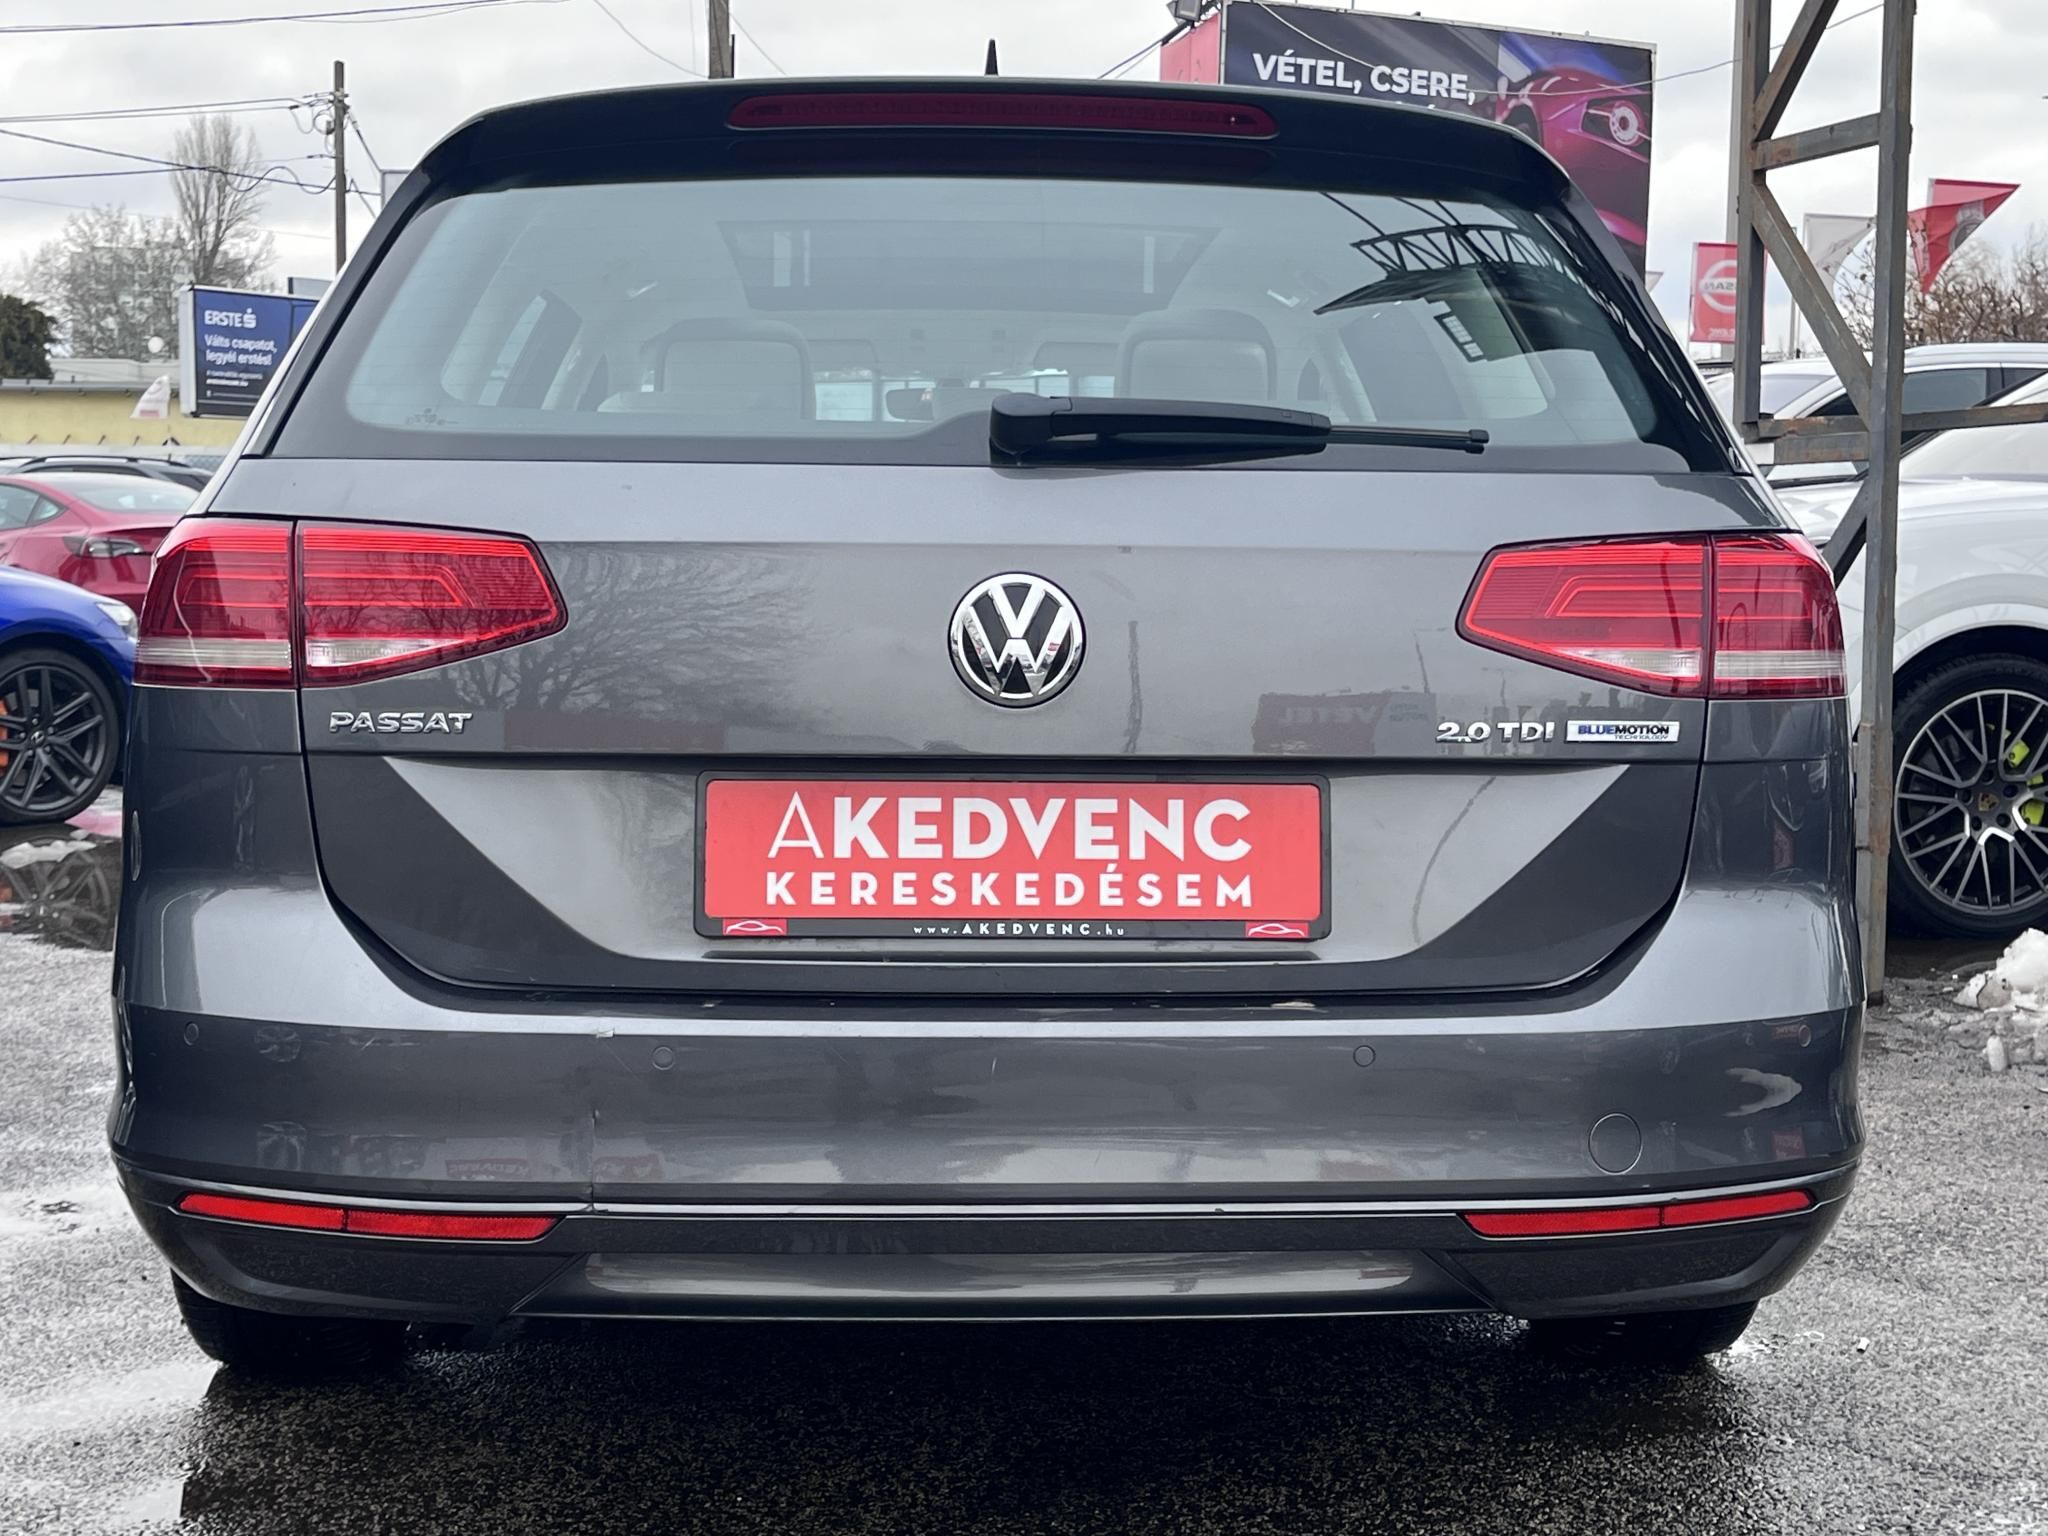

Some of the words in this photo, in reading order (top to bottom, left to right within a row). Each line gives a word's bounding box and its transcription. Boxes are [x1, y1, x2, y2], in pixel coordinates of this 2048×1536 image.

[1253, 49, 1362, 94] VÉTEL,
[1370, 65, 1476, 106] CSERE,
[204, 309, 243, 328] ERSTE
[329, 711, 473, 734] PASSAT
[1436, 721, 1492, 742] 2.0
[1496, 721, 1556, 742] TDI
[1578, 724, 1670, 735] BLUEMOTION
[766, 863, 1254, 907] KERESKEDÉSEM
